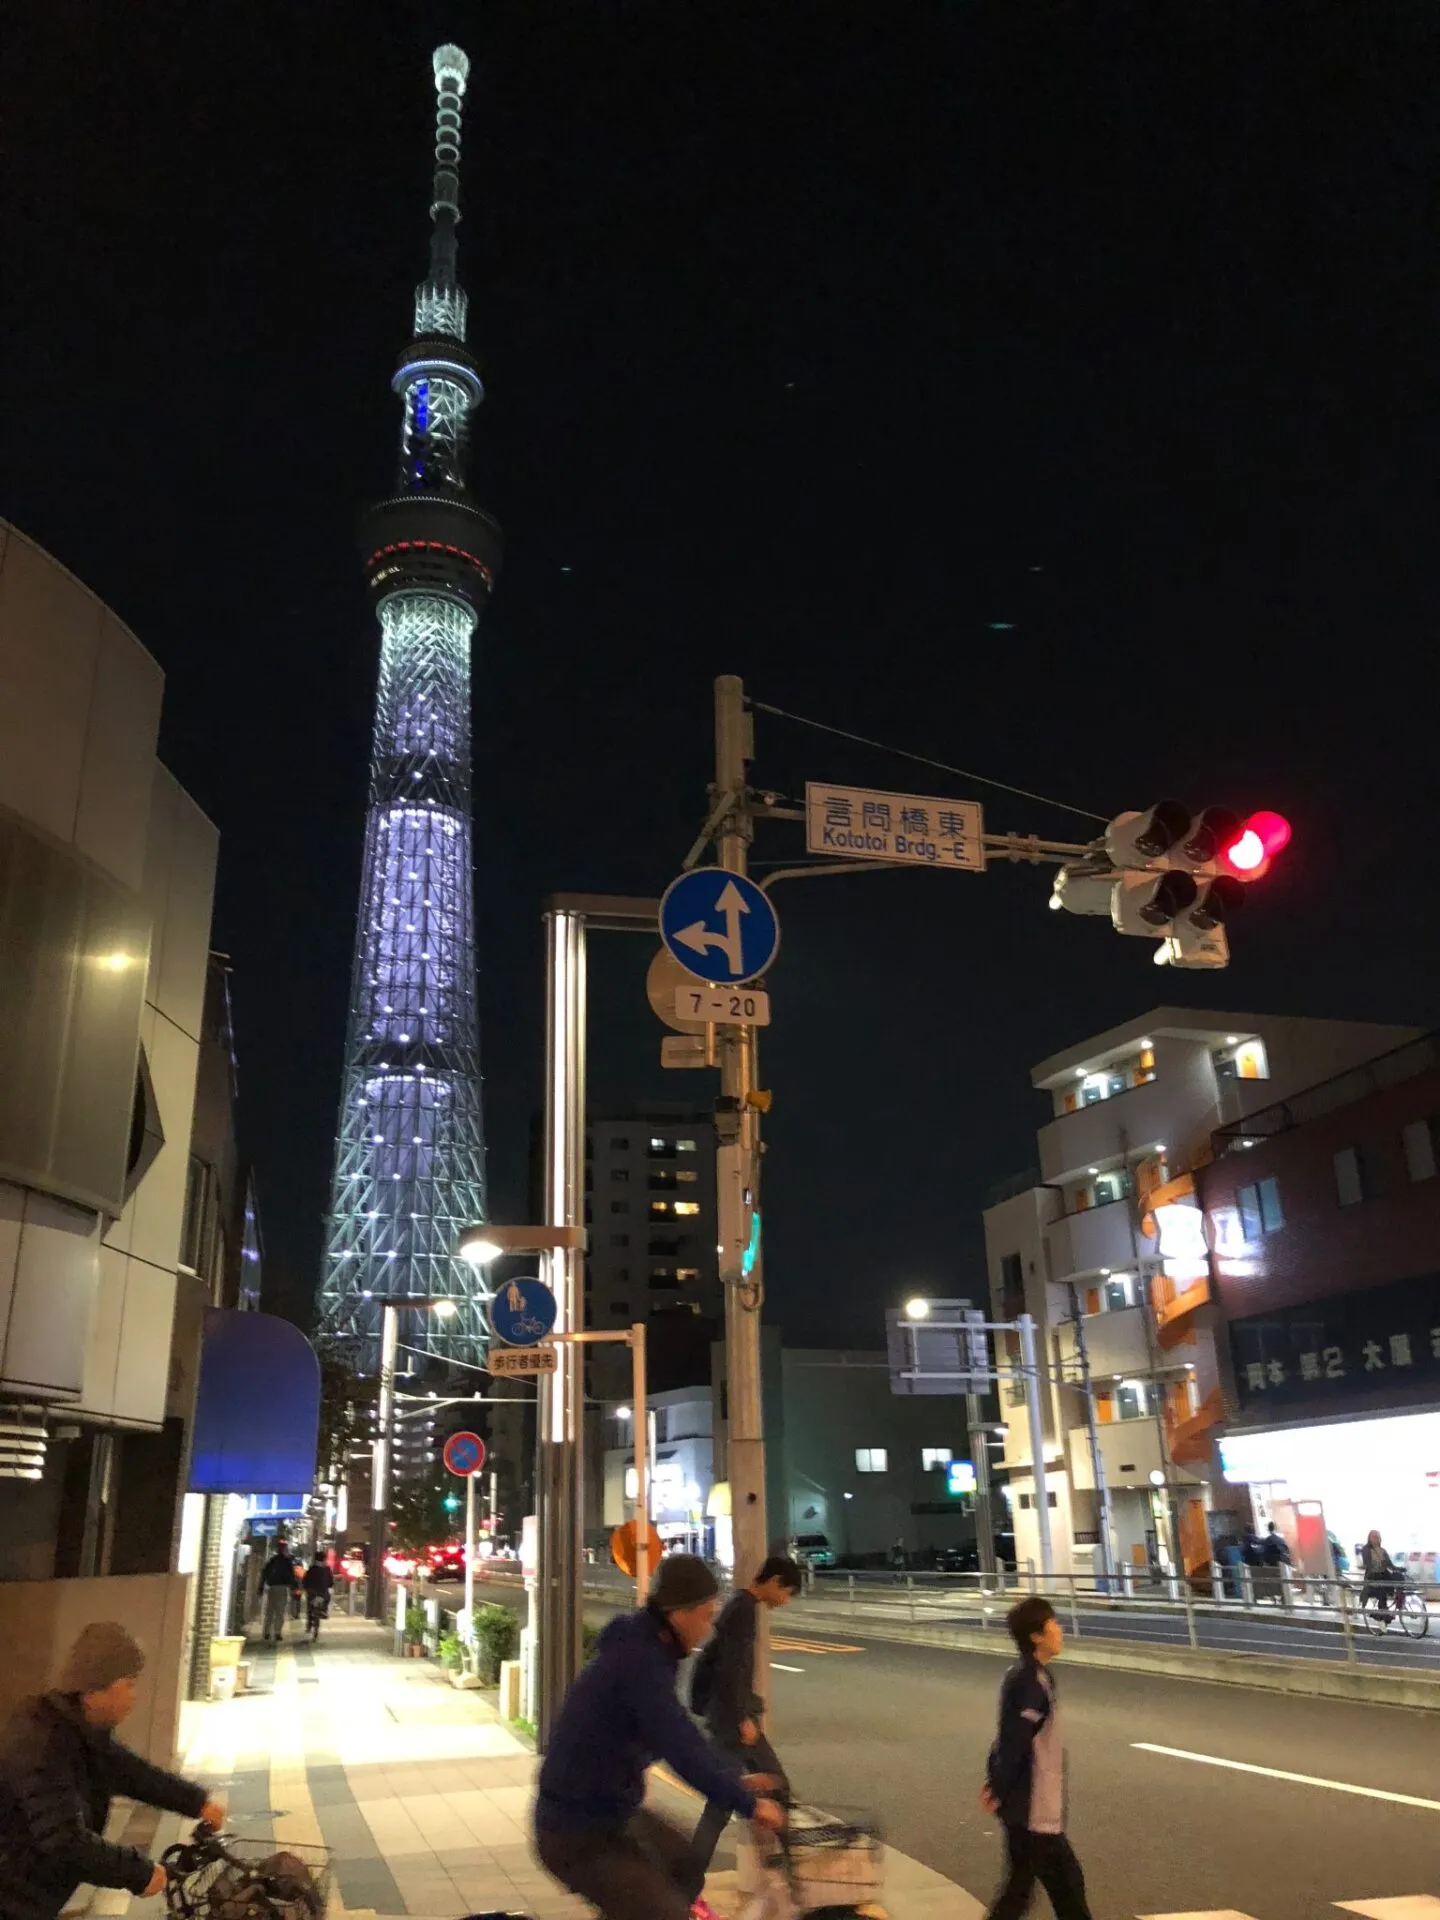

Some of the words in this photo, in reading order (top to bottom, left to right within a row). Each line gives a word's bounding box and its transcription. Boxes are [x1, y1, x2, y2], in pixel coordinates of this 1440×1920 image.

[823, 797, 967, 840] 言問橋東
[823, 827, 887, 851] Kototoi
[494, 1353, 553, 1370] 歩行者優先
